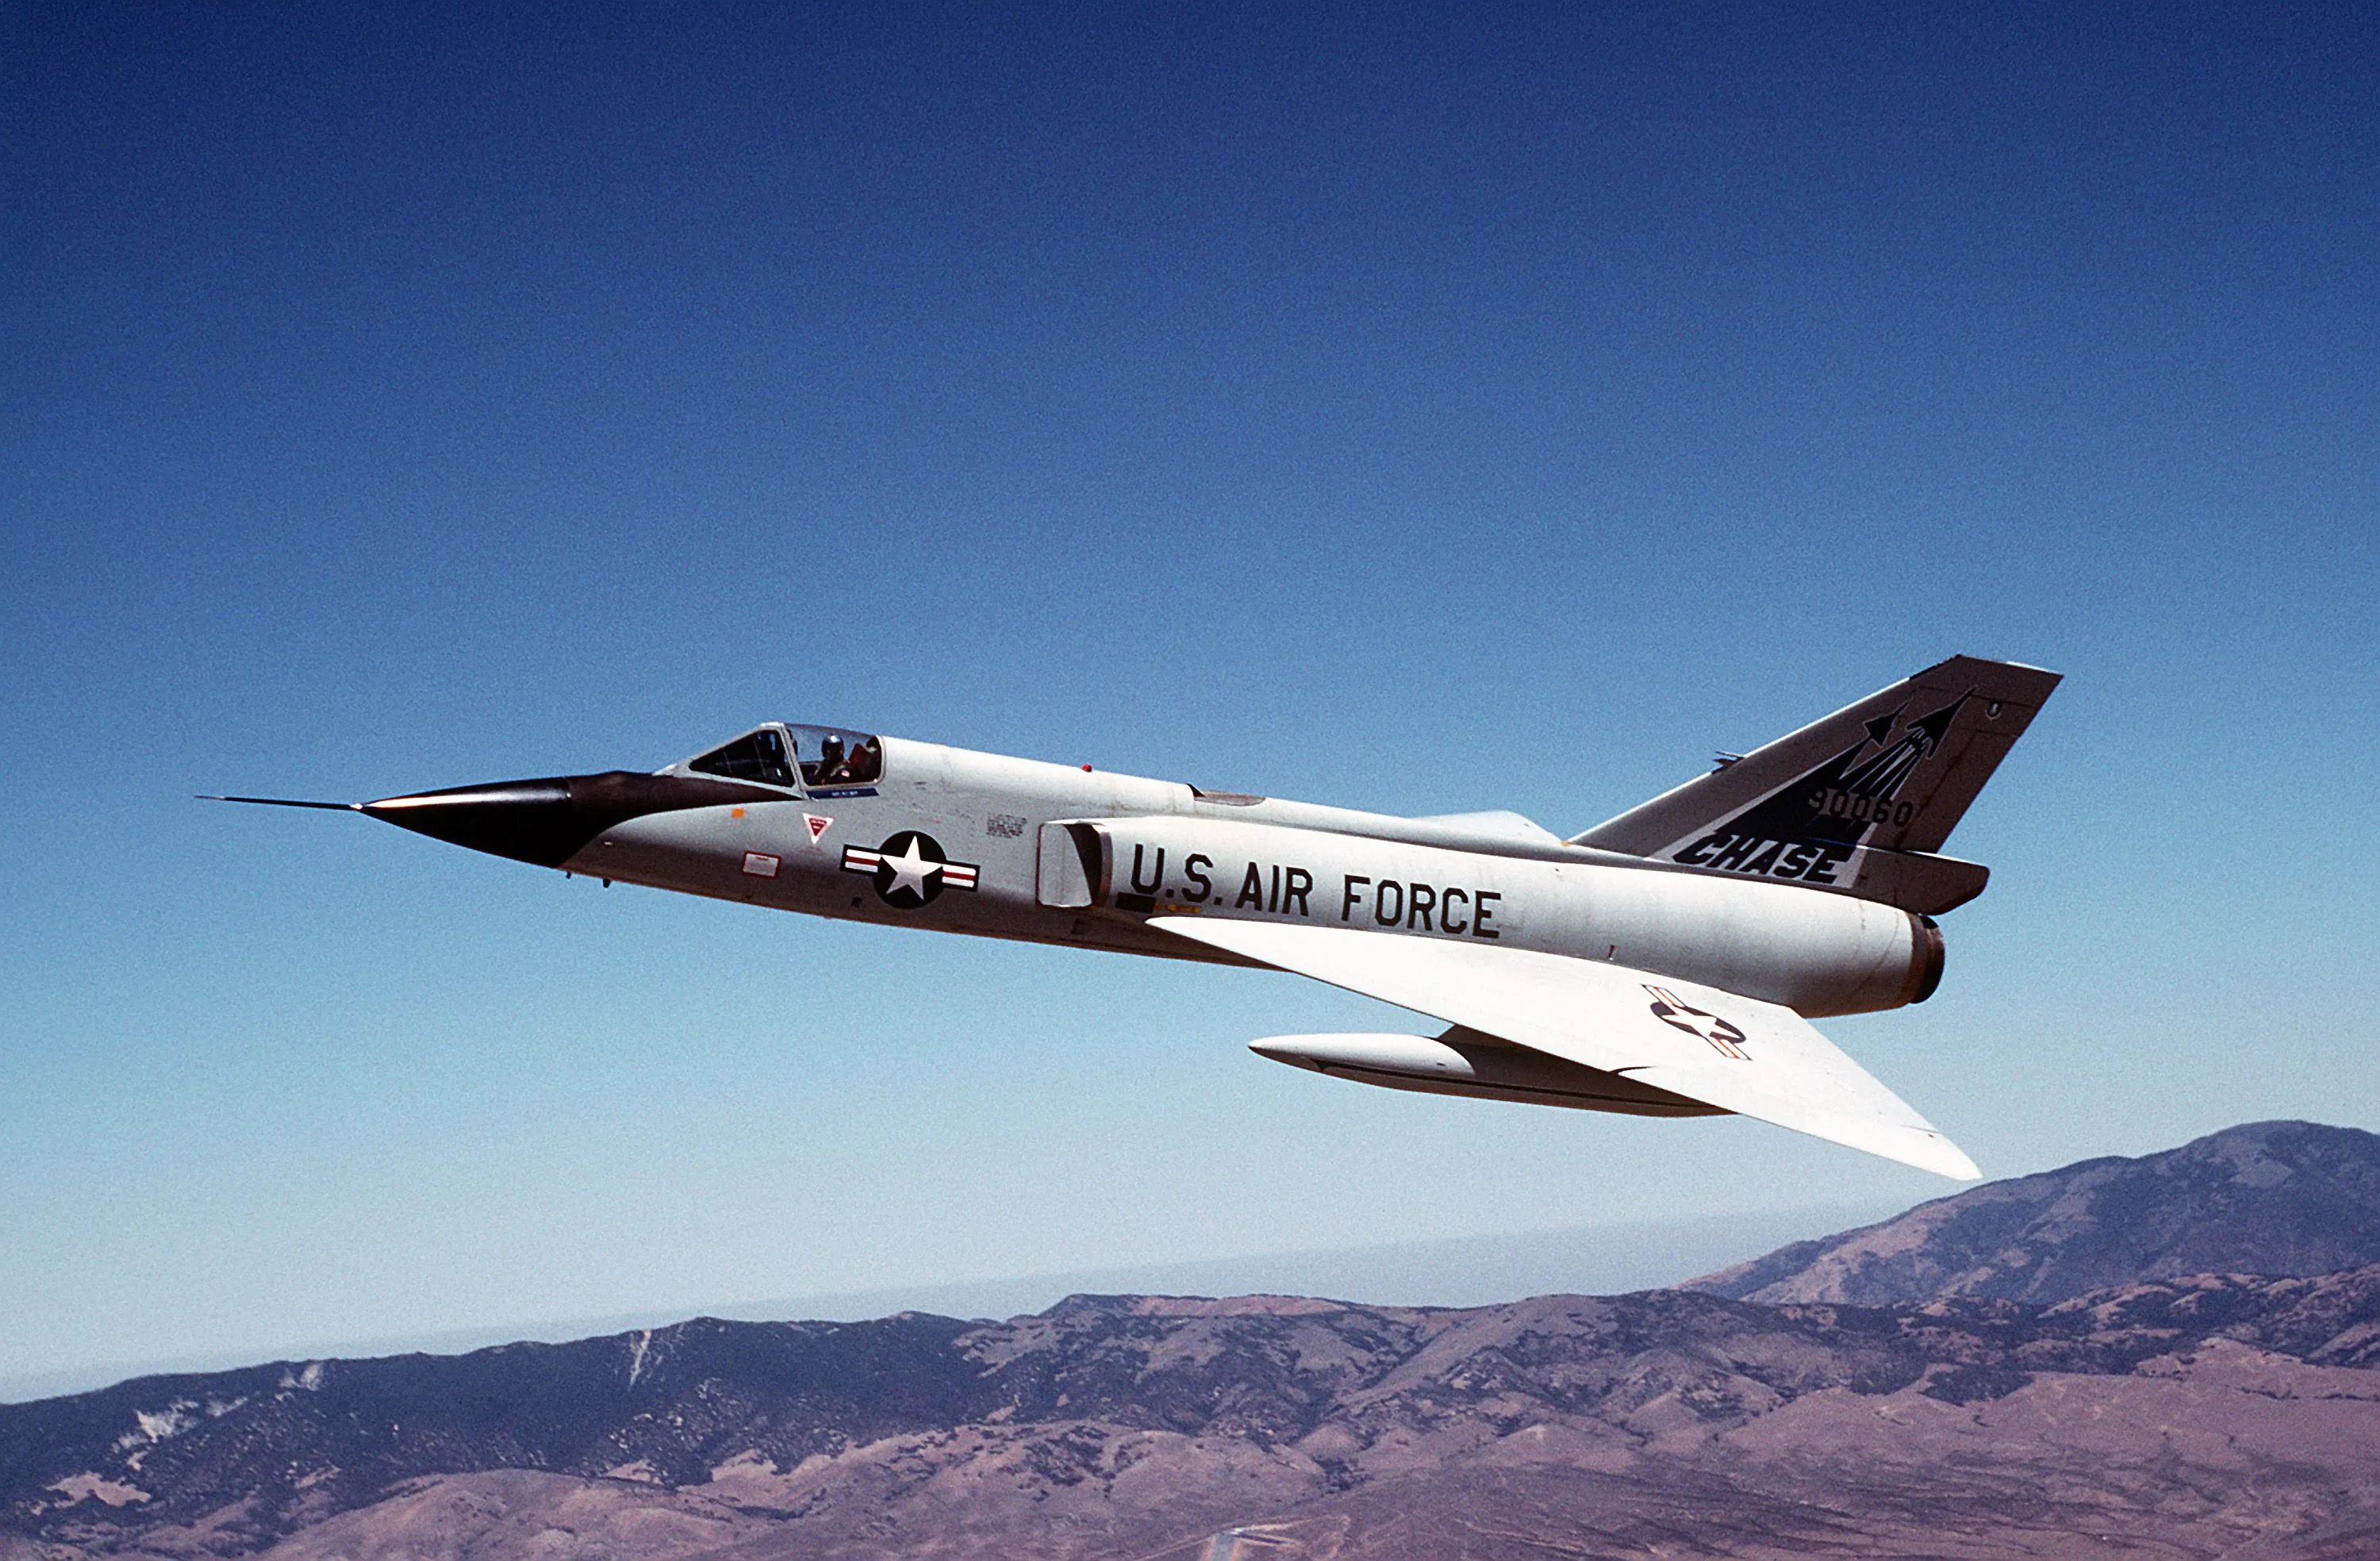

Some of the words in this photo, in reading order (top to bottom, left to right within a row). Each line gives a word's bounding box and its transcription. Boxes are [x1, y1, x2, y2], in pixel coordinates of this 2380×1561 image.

[1806, 787, 1914, 827] 90060
[1672, 834, 1851, 884] CHASE
[1130, 843, 1223, 906] U.S.
[1234, 861, 1313, 917] AIR
[1342, 875, 1502, 938] FORCE
